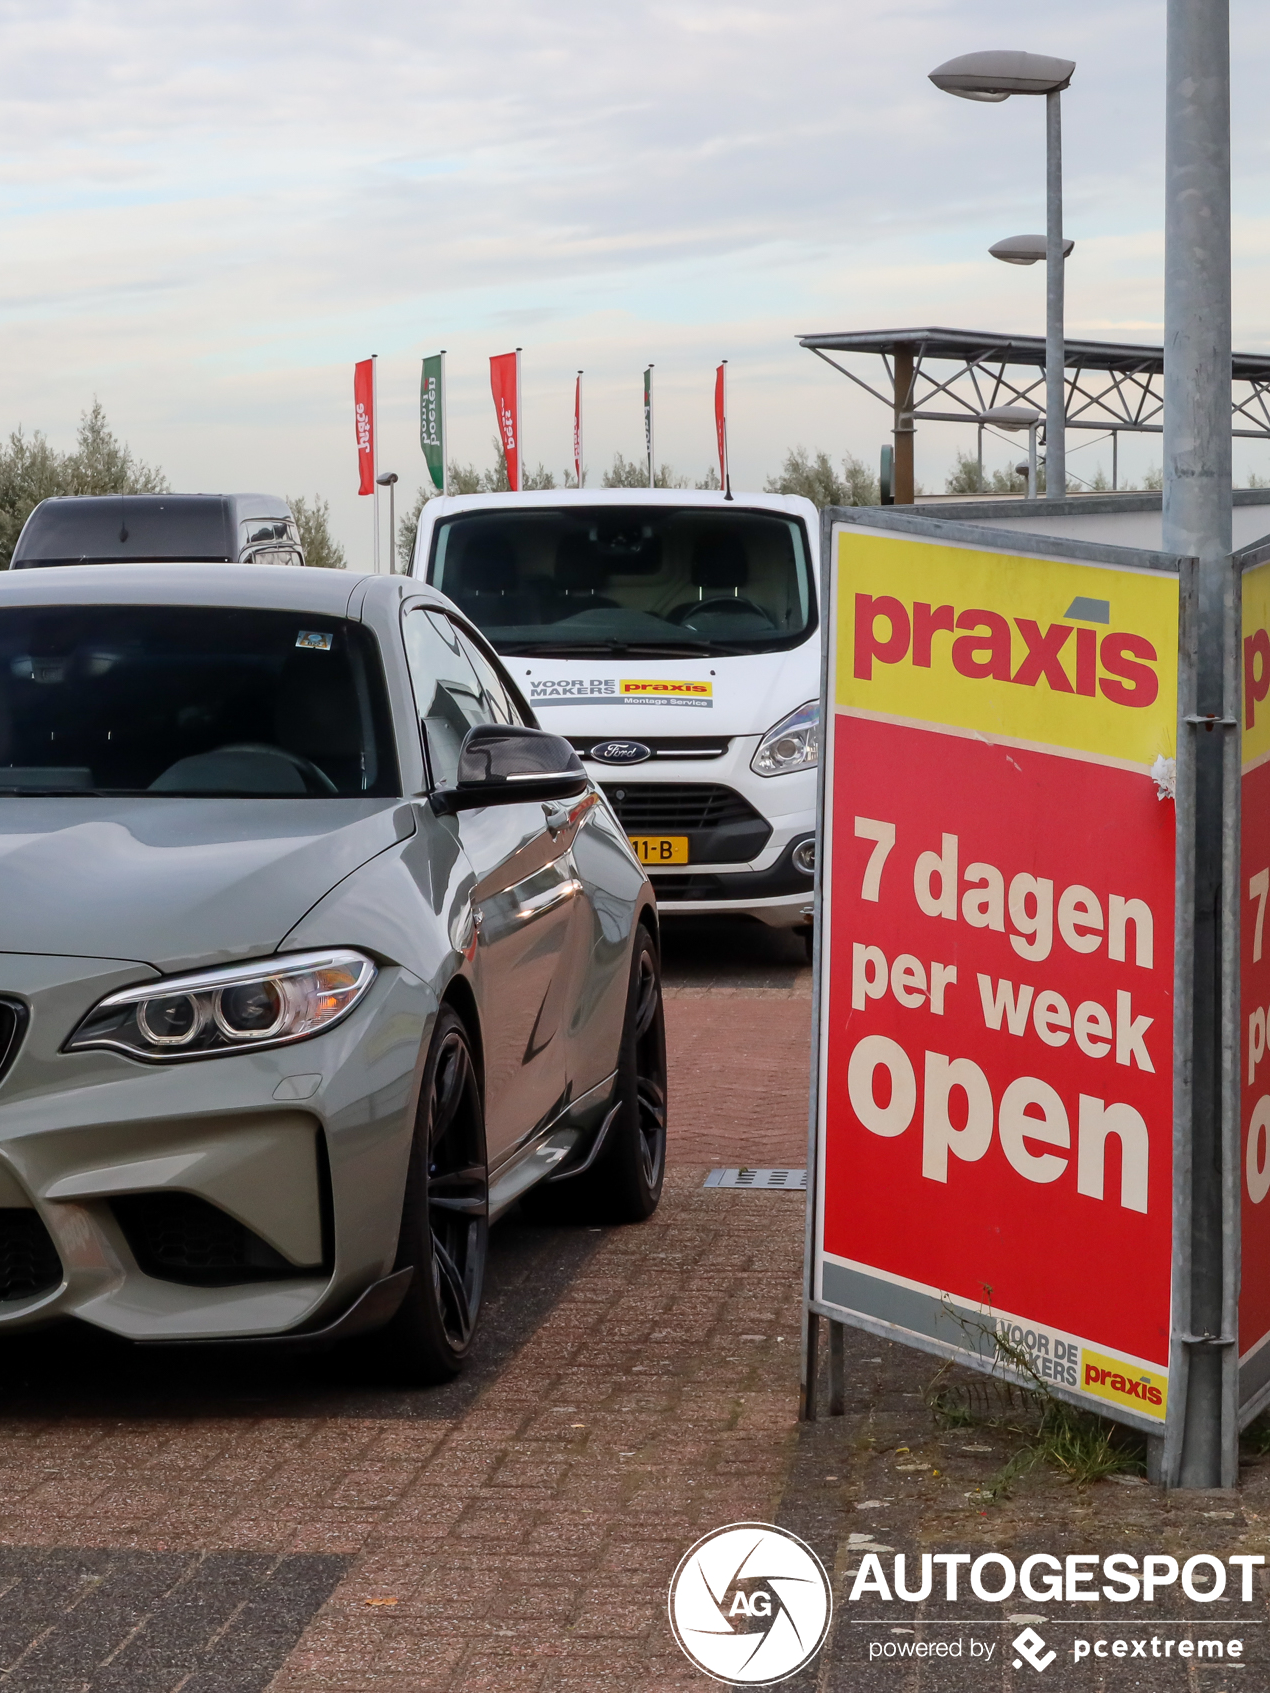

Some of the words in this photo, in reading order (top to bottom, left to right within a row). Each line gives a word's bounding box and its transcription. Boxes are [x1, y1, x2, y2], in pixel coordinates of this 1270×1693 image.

[853, 592, 1159, 709] praxis
[530, 679, 582, 689] VOOR
[589, 679, 616, 687] DE
[530, 687, 616, 697] MAKERS
[624, 683, 708, 693] praxis
[624, 697, 668, 706] Montage
[670, 698, 708, 707] Service
[604, 743, 638, 758] Ford
[853, 815, 896, 903] 7
[913, 832, 1155, 971] dagen
[1249, 866, 1270, 964] 7
[851, 942, 958, 1016] per
[976, 972, 1157, 1074] week
[1248, 1005, 1270, 1087] p
[847, 1034, 1150, 1215] open
[1000, 1320, 1050, 1356] VOOR
[1054, 1338, 1079, 1366] DE
[1000, 1347, 1078, 1387] KERS
[1085, 1363, 1163, 1406] praxis
